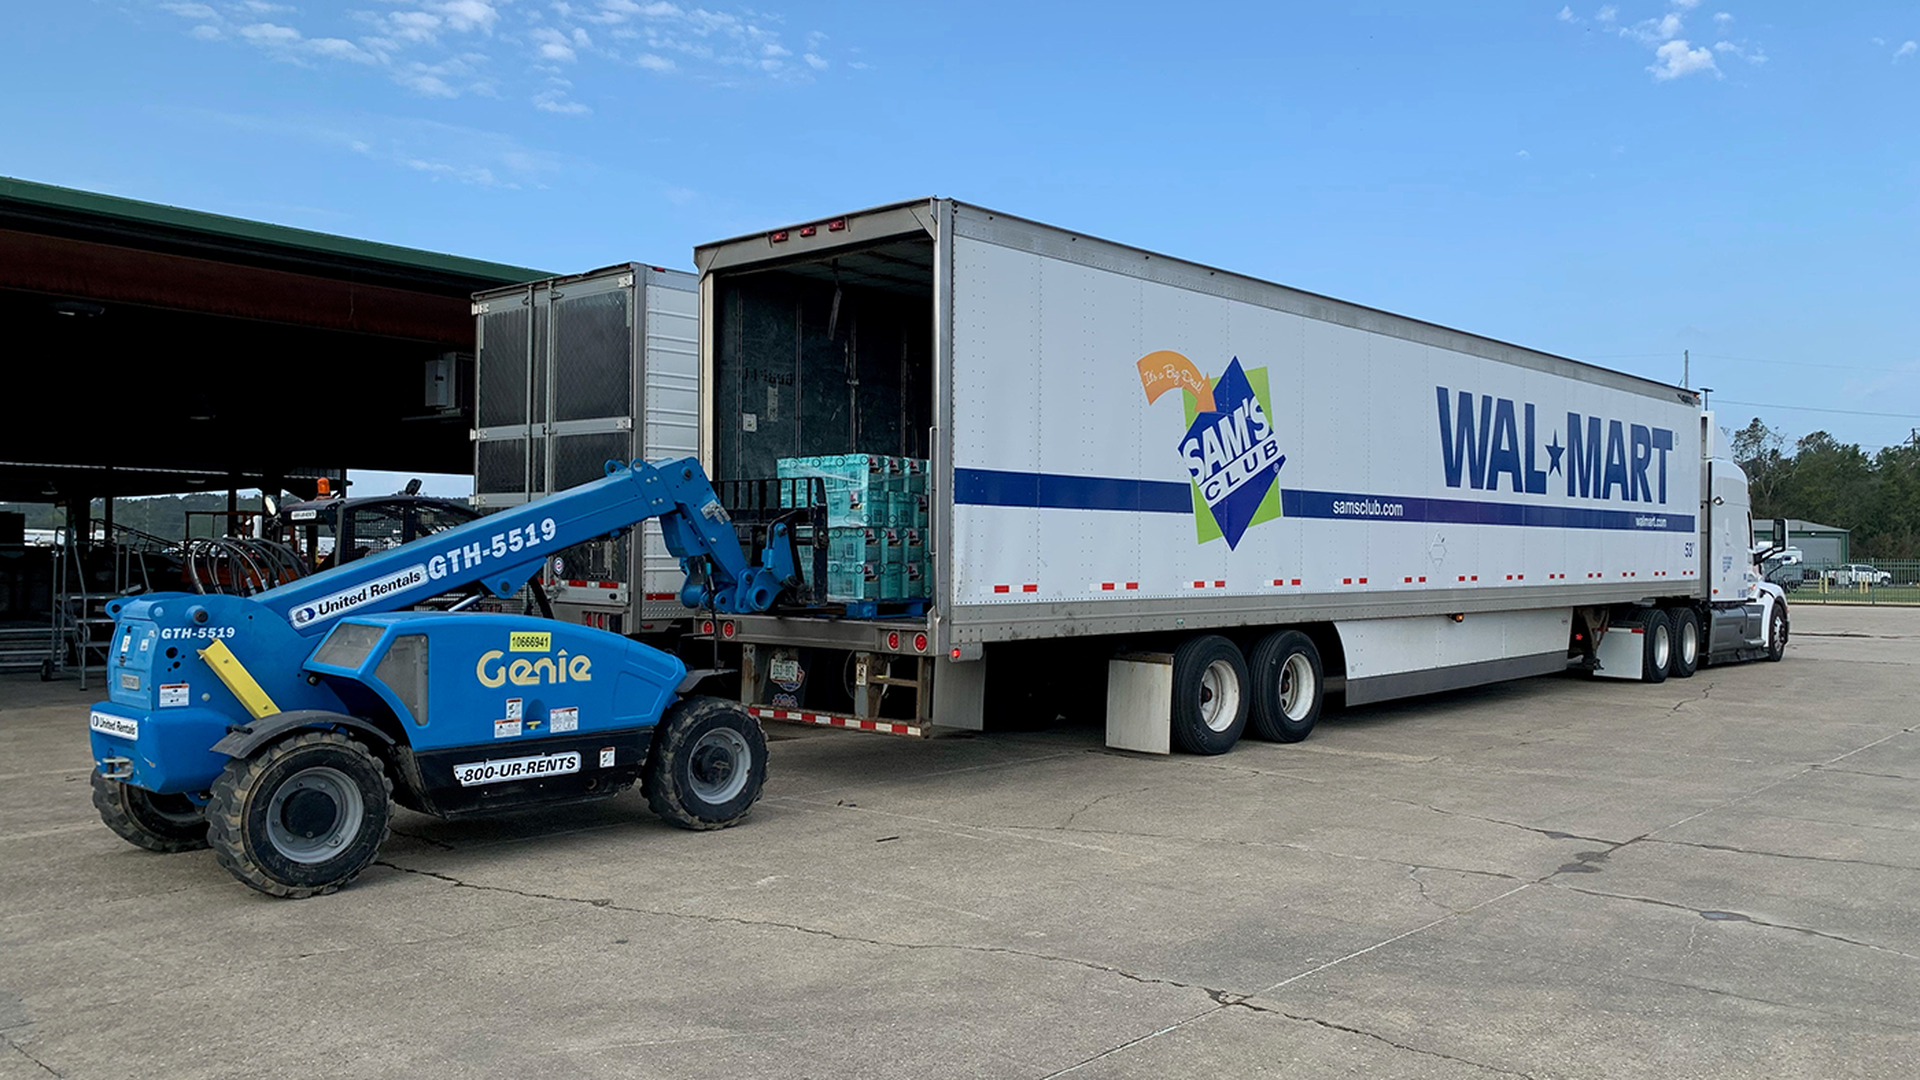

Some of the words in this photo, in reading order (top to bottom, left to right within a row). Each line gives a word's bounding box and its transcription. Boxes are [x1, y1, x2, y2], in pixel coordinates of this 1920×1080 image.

[1163, 364, 1180, 386] Big
[1181, 396, 1272, 486] SAM'S
[1205, 439, 1279, 501] CLUB
[1333, 499, 1403, 517] samsclub.com
[1635, 514, 1667, 527] walmart.com
[427, 518, 557, 581] GTH-5519
[318, 586, 368, 616] United
[369, 570, 422, 601] Rentals
[161, 627, 235, 640] GTH-5519
[512, 636, 550, 649] 10666941
[476, 649, 592, 689] Genie
[99, 717, 116, 731] United
[116, 721, 136, 736] Rentals
[454, 756, 576, 782] -800-UR-RENTS
